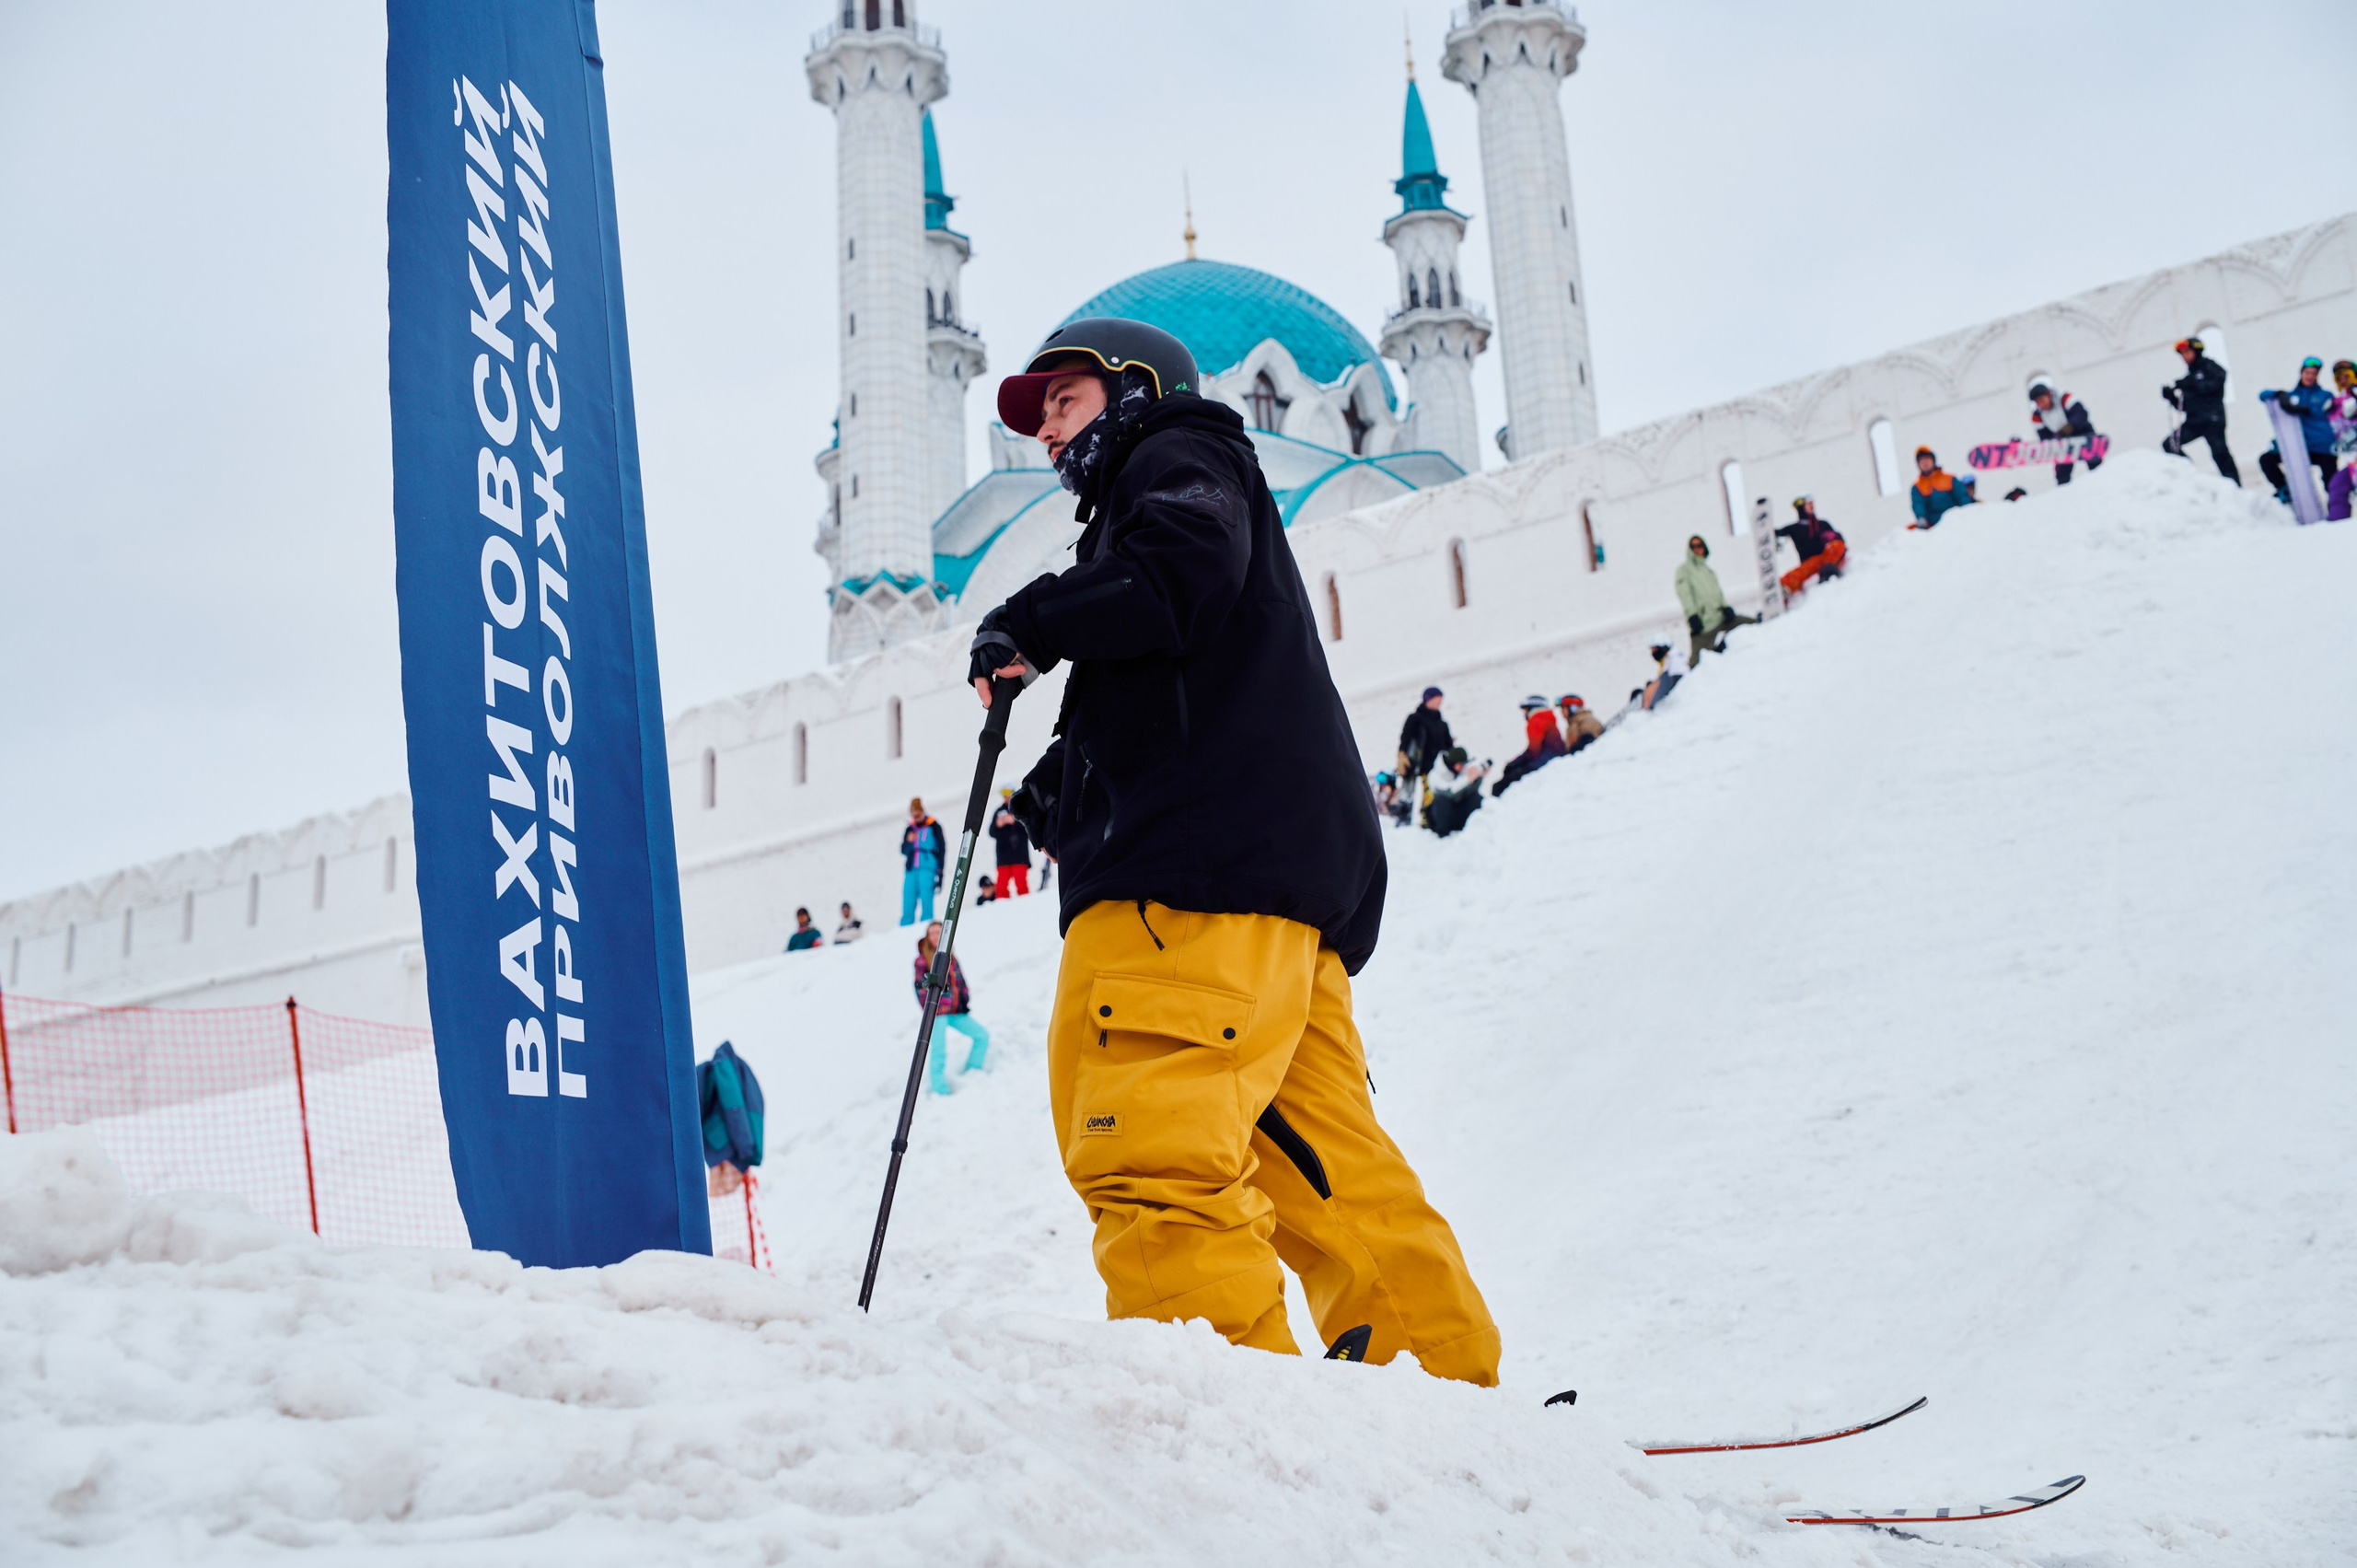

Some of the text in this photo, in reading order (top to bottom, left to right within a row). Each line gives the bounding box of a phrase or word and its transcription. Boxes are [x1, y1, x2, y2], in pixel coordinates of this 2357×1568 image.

[454, 75, 548, 1098] ВАХИТОВСКИЙ
[501, 79, 587, 1099] ПРИВОЛЖСКИЙ
[949, 878, 960, 909] Quechua
